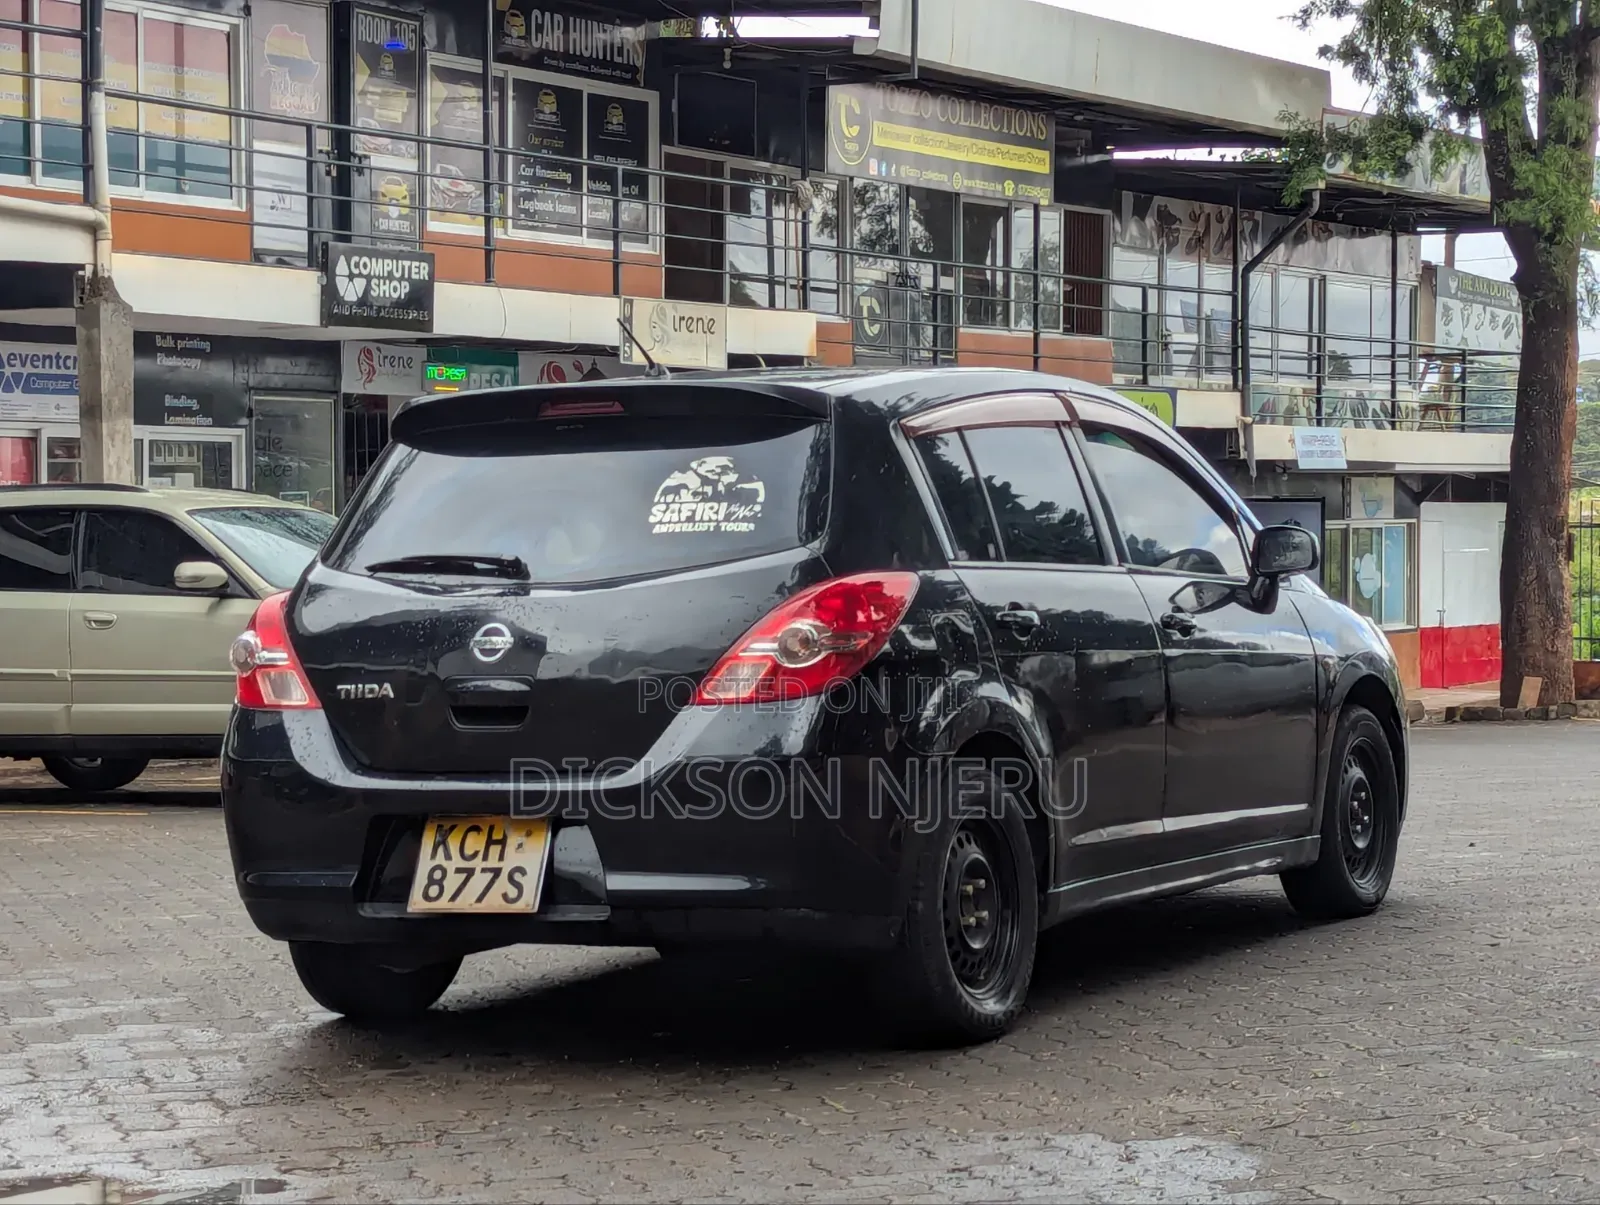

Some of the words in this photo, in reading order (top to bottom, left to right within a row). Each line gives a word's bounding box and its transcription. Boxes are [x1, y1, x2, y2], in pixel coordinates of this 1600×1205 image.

[357, 13, 391, 46] ROOM
[394, 23, 416, 51] 105
[531, 9, 564, 52] CAR
[875, 82, 932, 119] TOZZO
[936, 94, 1047, 140] COLLECTIONS
[536, 165, 572, 184] financing
[350, 255, 430, 281] COMPUTER
[370, 278, 410, 300] SHOP
[332, 303, 351, 316] AND
[351, 306, 378, 318] PHONE
[379, 307, 430, 321] ACCESSORIES
[155, 334, 176, 348] Bulk
[177, 337, 211, 353] printing
[156, 353, 202, 370] Photocopy
[377, 348, 414, 369] irene
[30, 376, 73, 392] Computer
[164, 412, 213, 426] Lamination
[648, 502, 728, 523] SAFIRI
[336, 682, 395, 700] TIIDA
[430, 824, 508, 862] KCH
[421, 864, 528, 904] 877S
